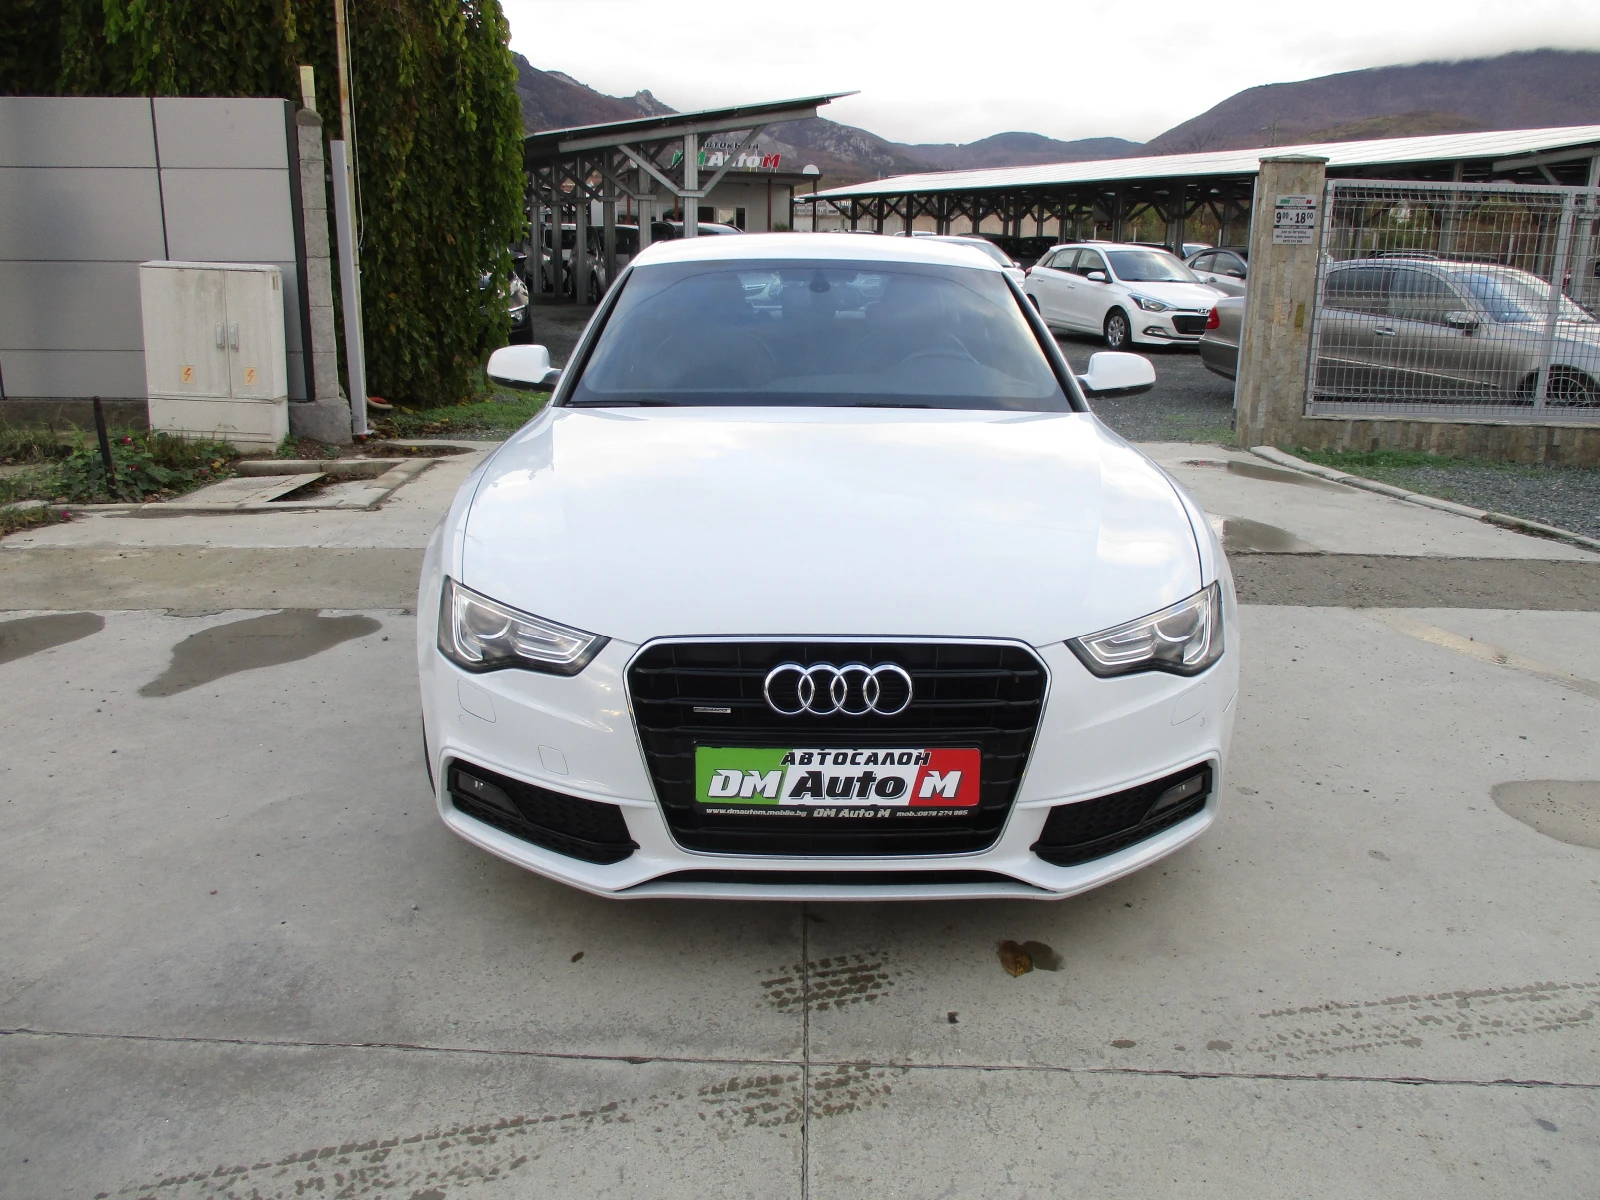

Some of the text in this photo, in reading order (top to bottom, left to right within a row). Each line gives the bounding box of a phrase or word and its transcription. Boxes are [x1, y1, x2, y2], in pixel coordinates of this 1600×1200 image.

[707, 152, 760, 168] Ato
[780, 752, 931, 766] АВТОСАЛОН
[707, 769, 964, 799] DM Auto M
[813, 808, 837, 818] DM
[838, 808, 875, 818] Auto
[877, 808, 892, 818] M
